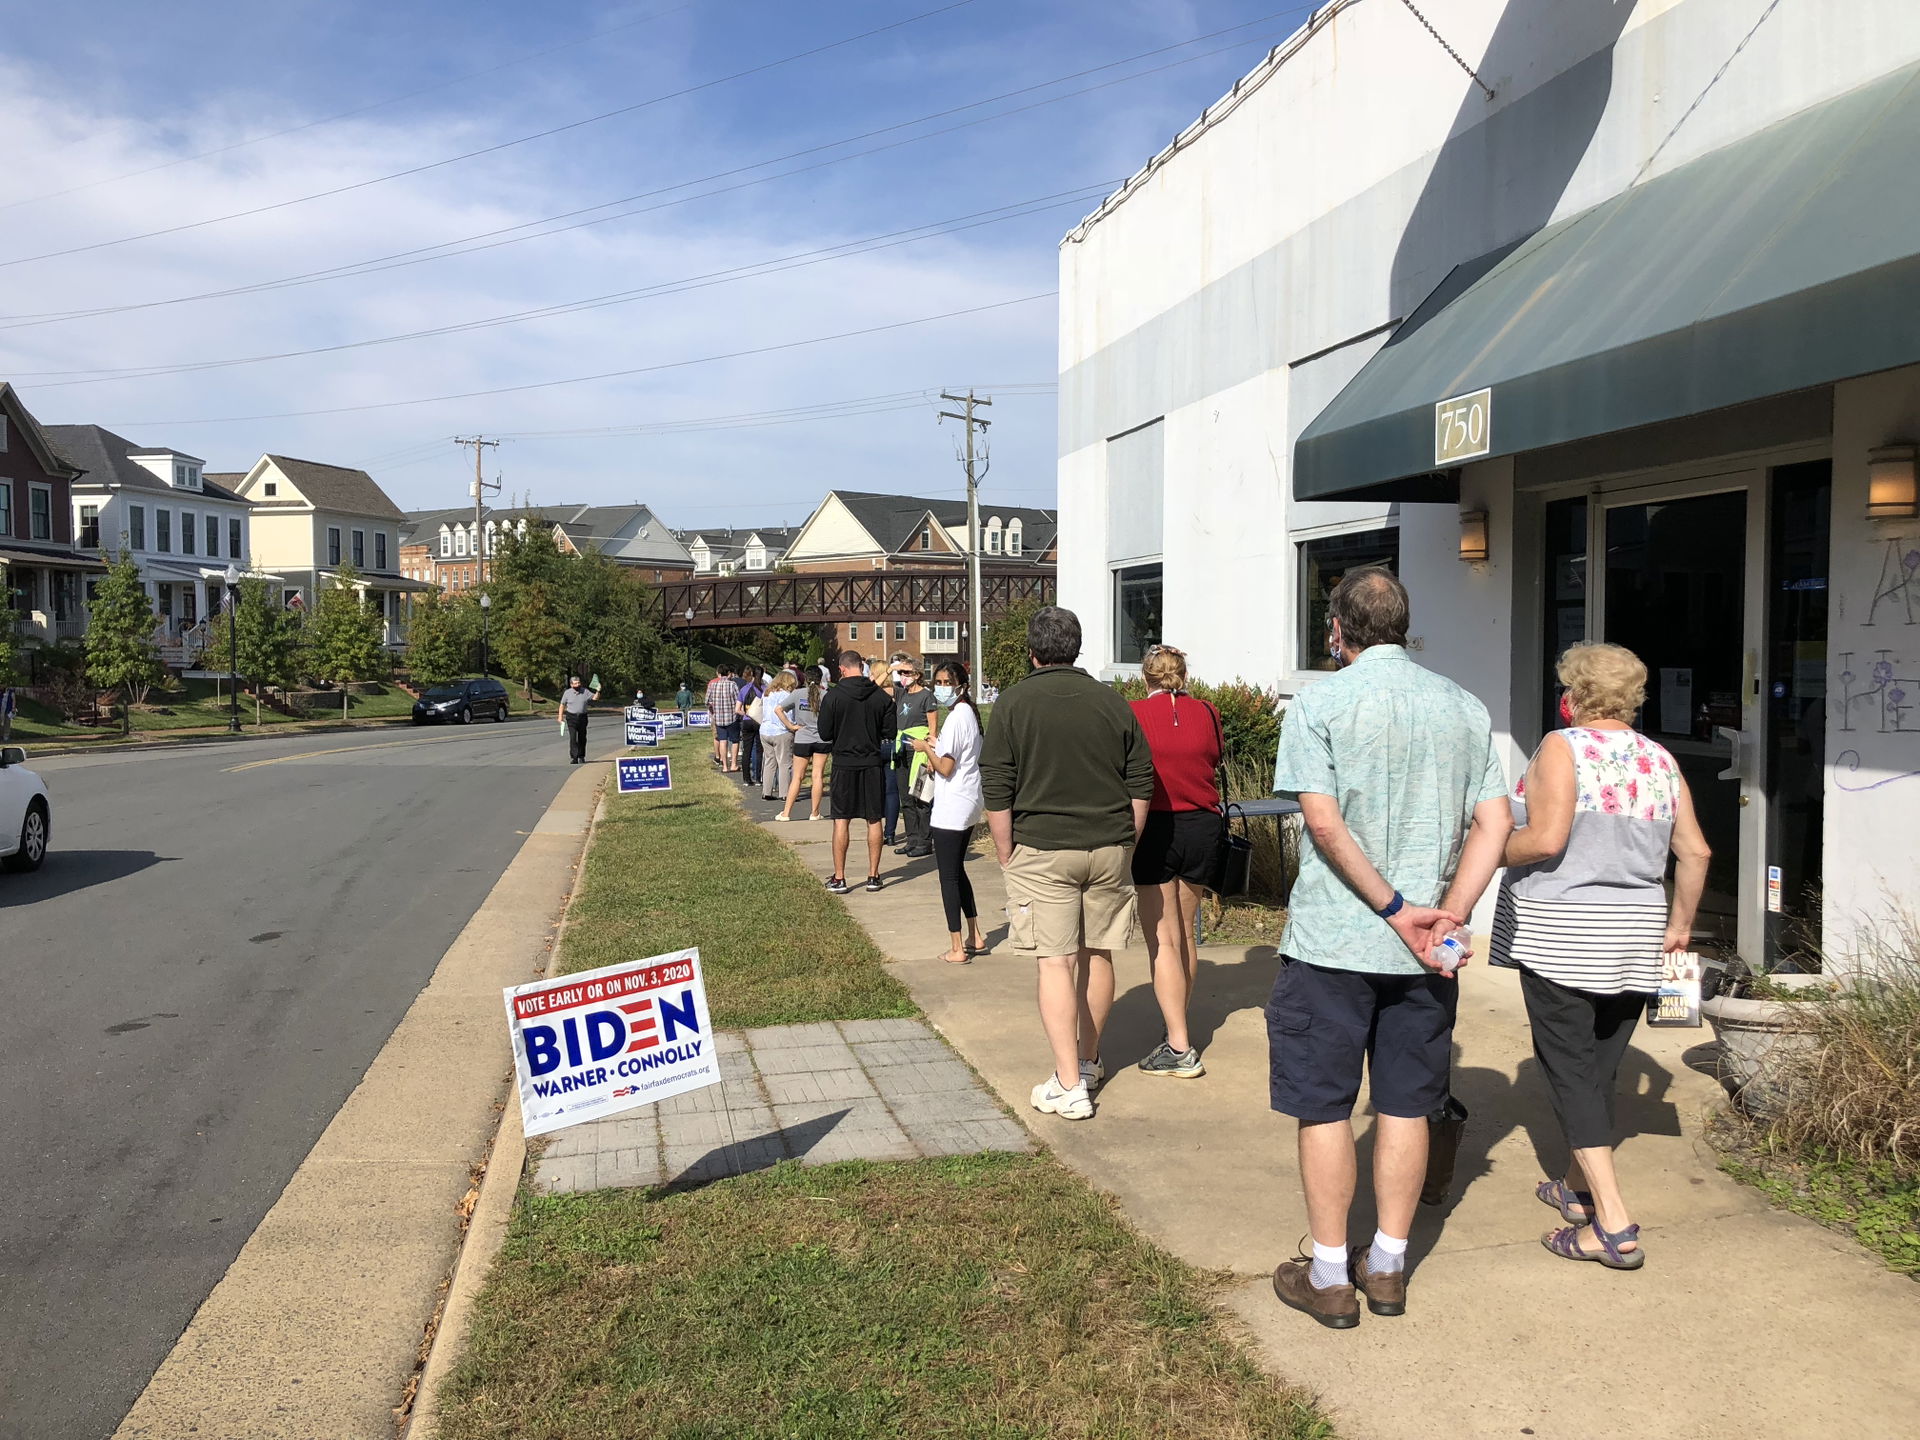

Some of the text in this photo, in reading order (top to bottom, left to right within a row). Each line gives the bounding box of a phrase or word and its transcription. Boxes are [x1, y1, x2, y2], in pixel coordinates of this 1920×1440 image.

[1441, 404, 1482, 450] 750
[628, 733, 655, 741] Warner
[621, 765, 666, 773] TRUMP
[517, 963, 690, 1015] VOTE EARLY OR ON NOV. 3, 2020
[522, 989, 700, 1077] BIDEN
[532, 1039, 702, 1099] WARNER CONNOLLY
[641, 1065, 711, 1091] fairfaxdemocrats.org
